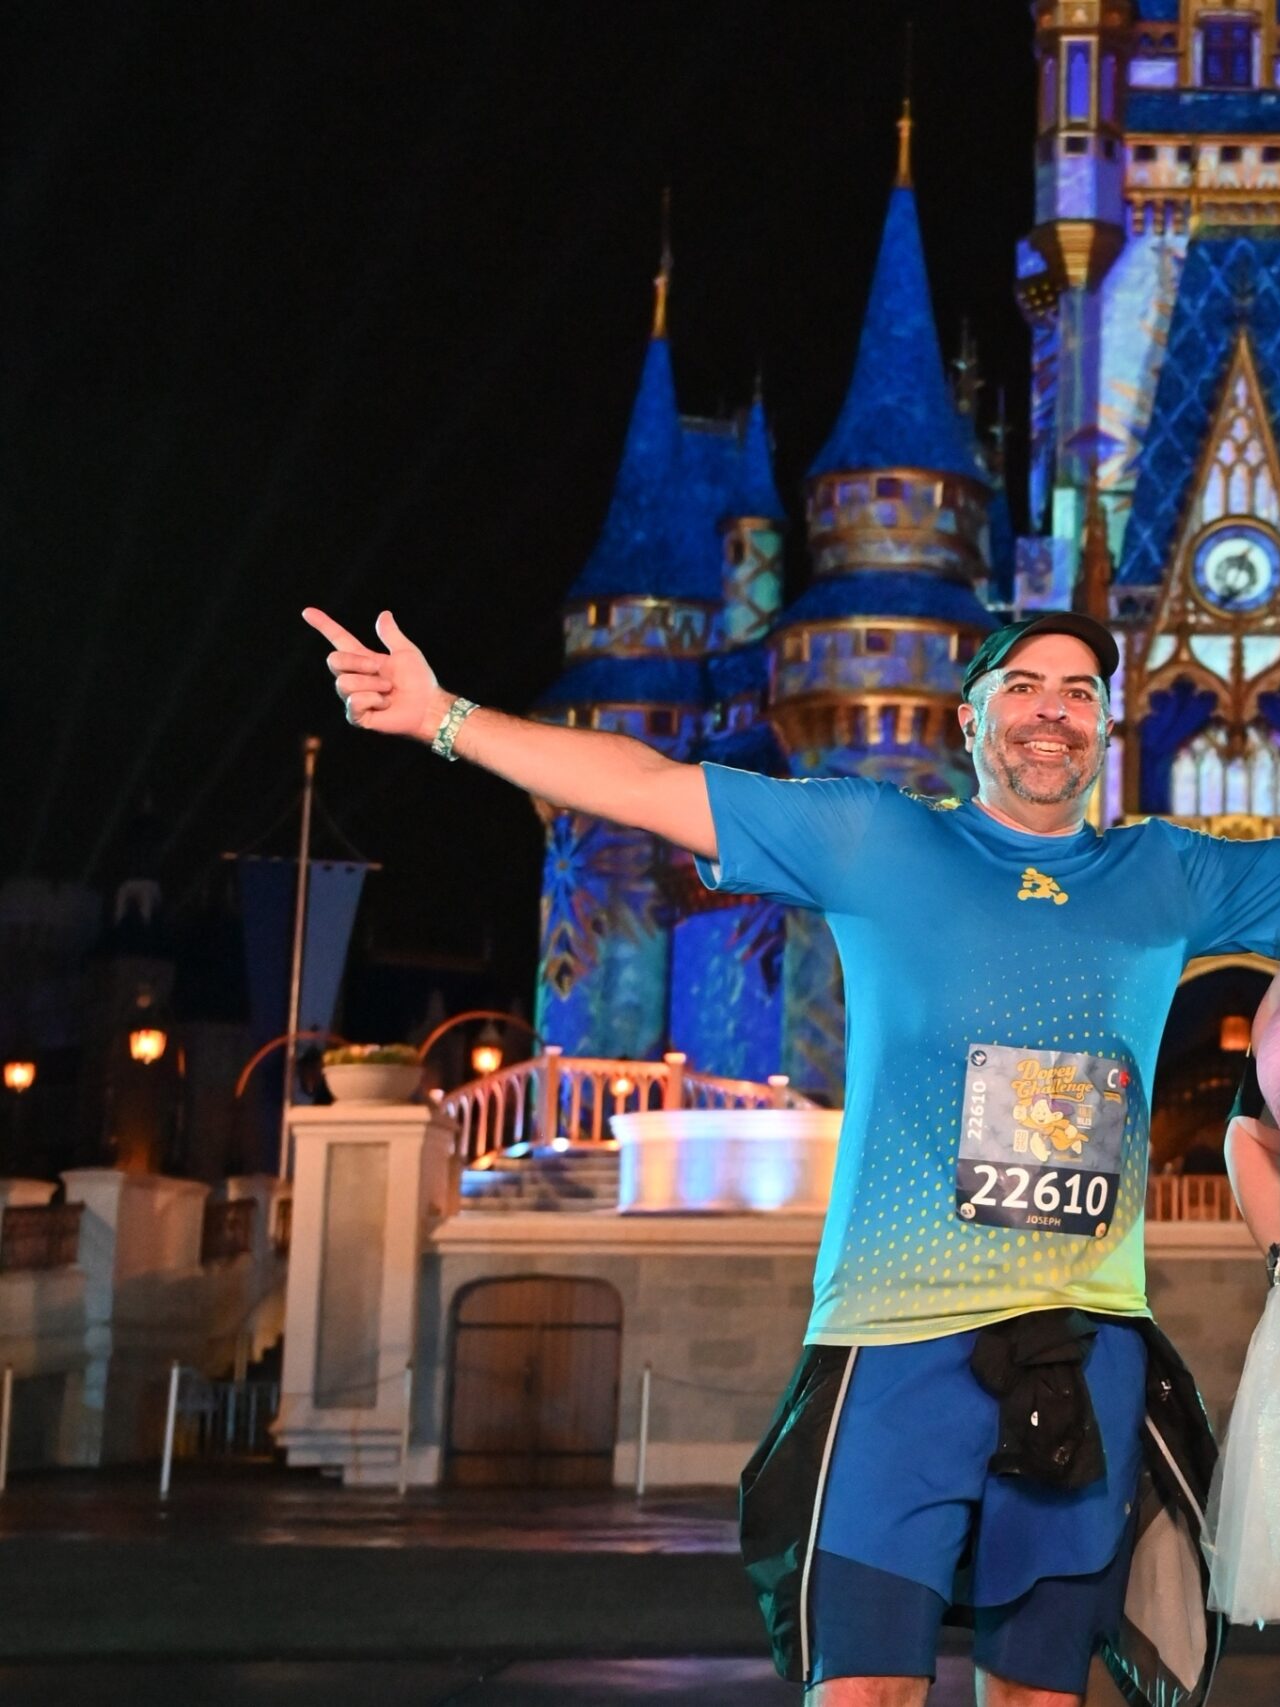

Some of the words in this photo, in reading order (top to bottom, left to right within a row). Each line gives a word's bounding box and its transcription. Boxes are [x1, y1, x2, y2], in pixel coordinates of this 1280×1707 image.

[1107, 1068, 1119, 1088] C
[1011, 1079, 1094, 1102] Challenge
[967, 1081, 986, 1140] 22610
[970, 1164, 1108, 1216] 22610
[1026, 1215, 1062, 1226] JOSEPH
